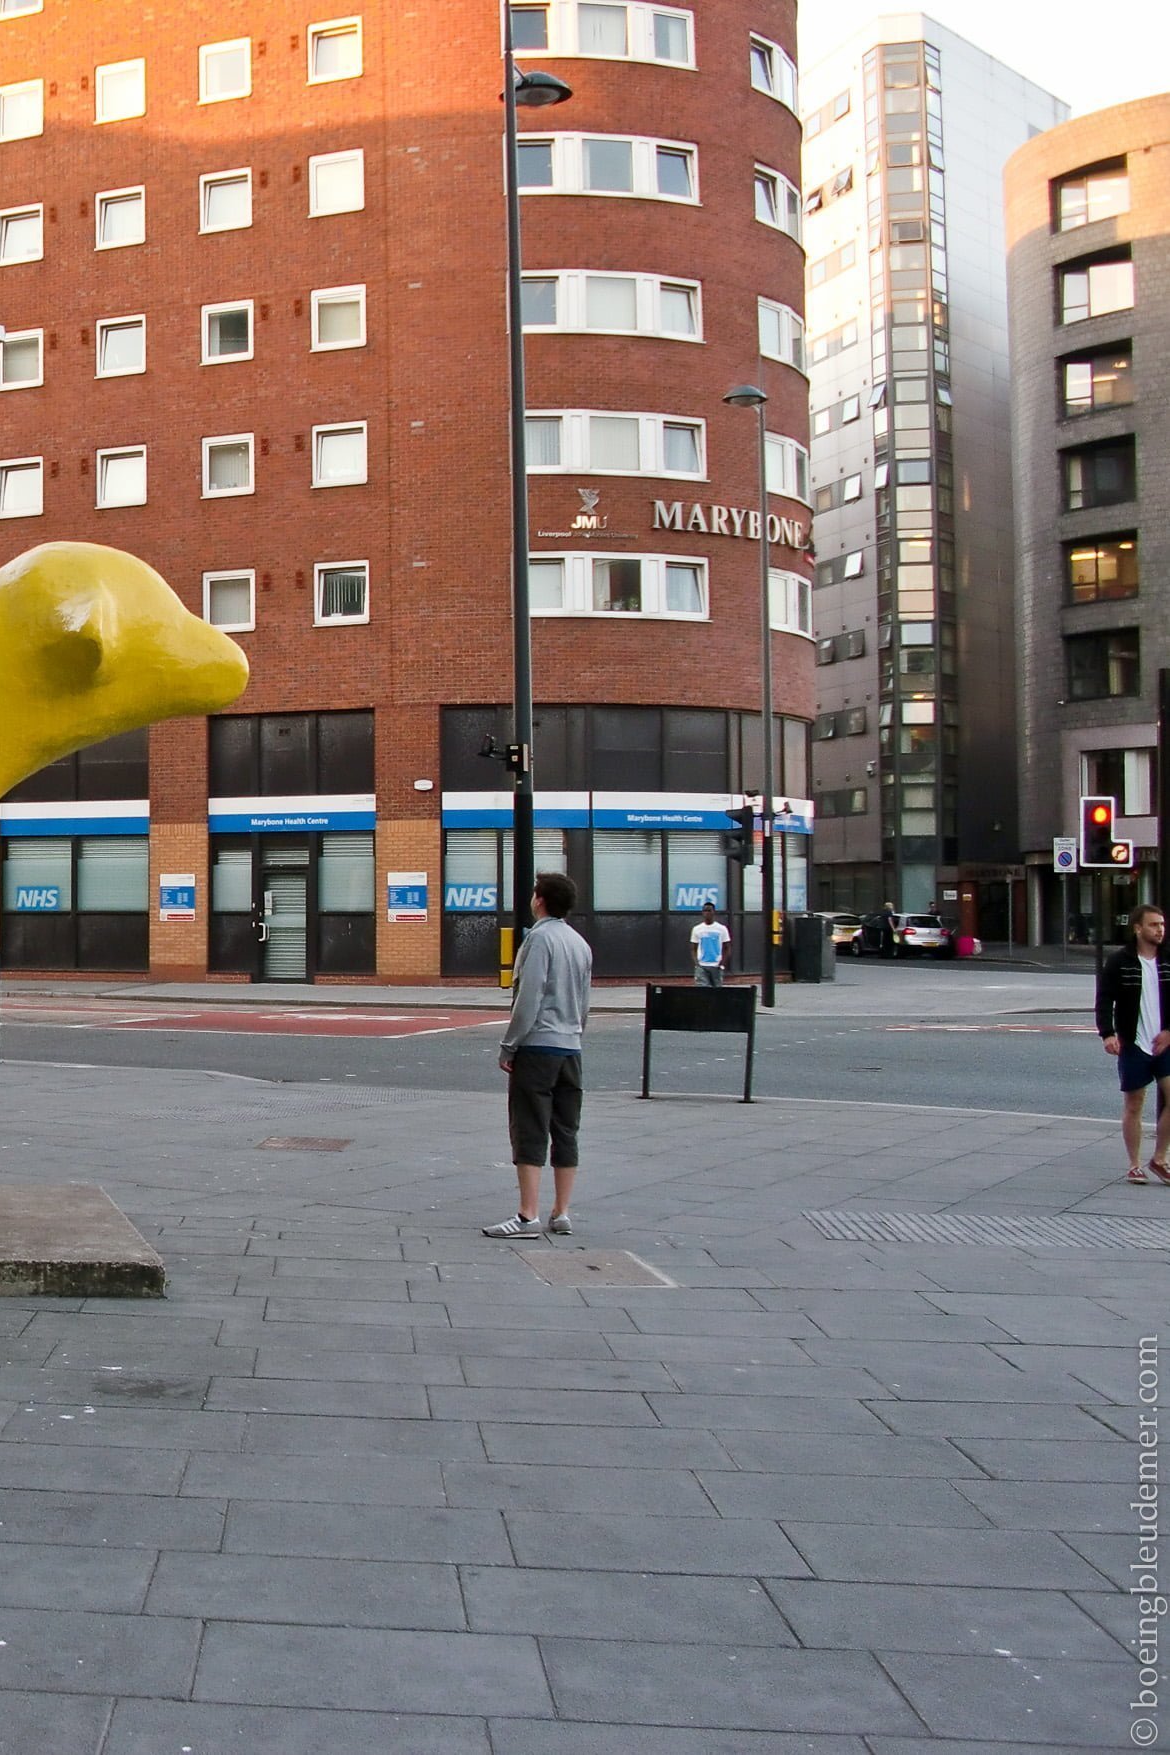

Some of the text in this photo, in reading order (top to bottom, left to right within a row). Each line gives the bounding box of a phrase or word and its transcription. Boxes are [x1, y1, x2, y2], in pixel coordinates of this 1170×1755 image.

[537, 530, 572, 538] Liverpool
[652, 500, 810, 550] MARYBONE
[251, 817, 329, 827] Marybone Health Centre
[627, 814, 661, 824] Marybone
[18, 889, 58, 907] NHS
[445, 887, 497, 907] NHS
[676, 887, 718, 906] NHS
